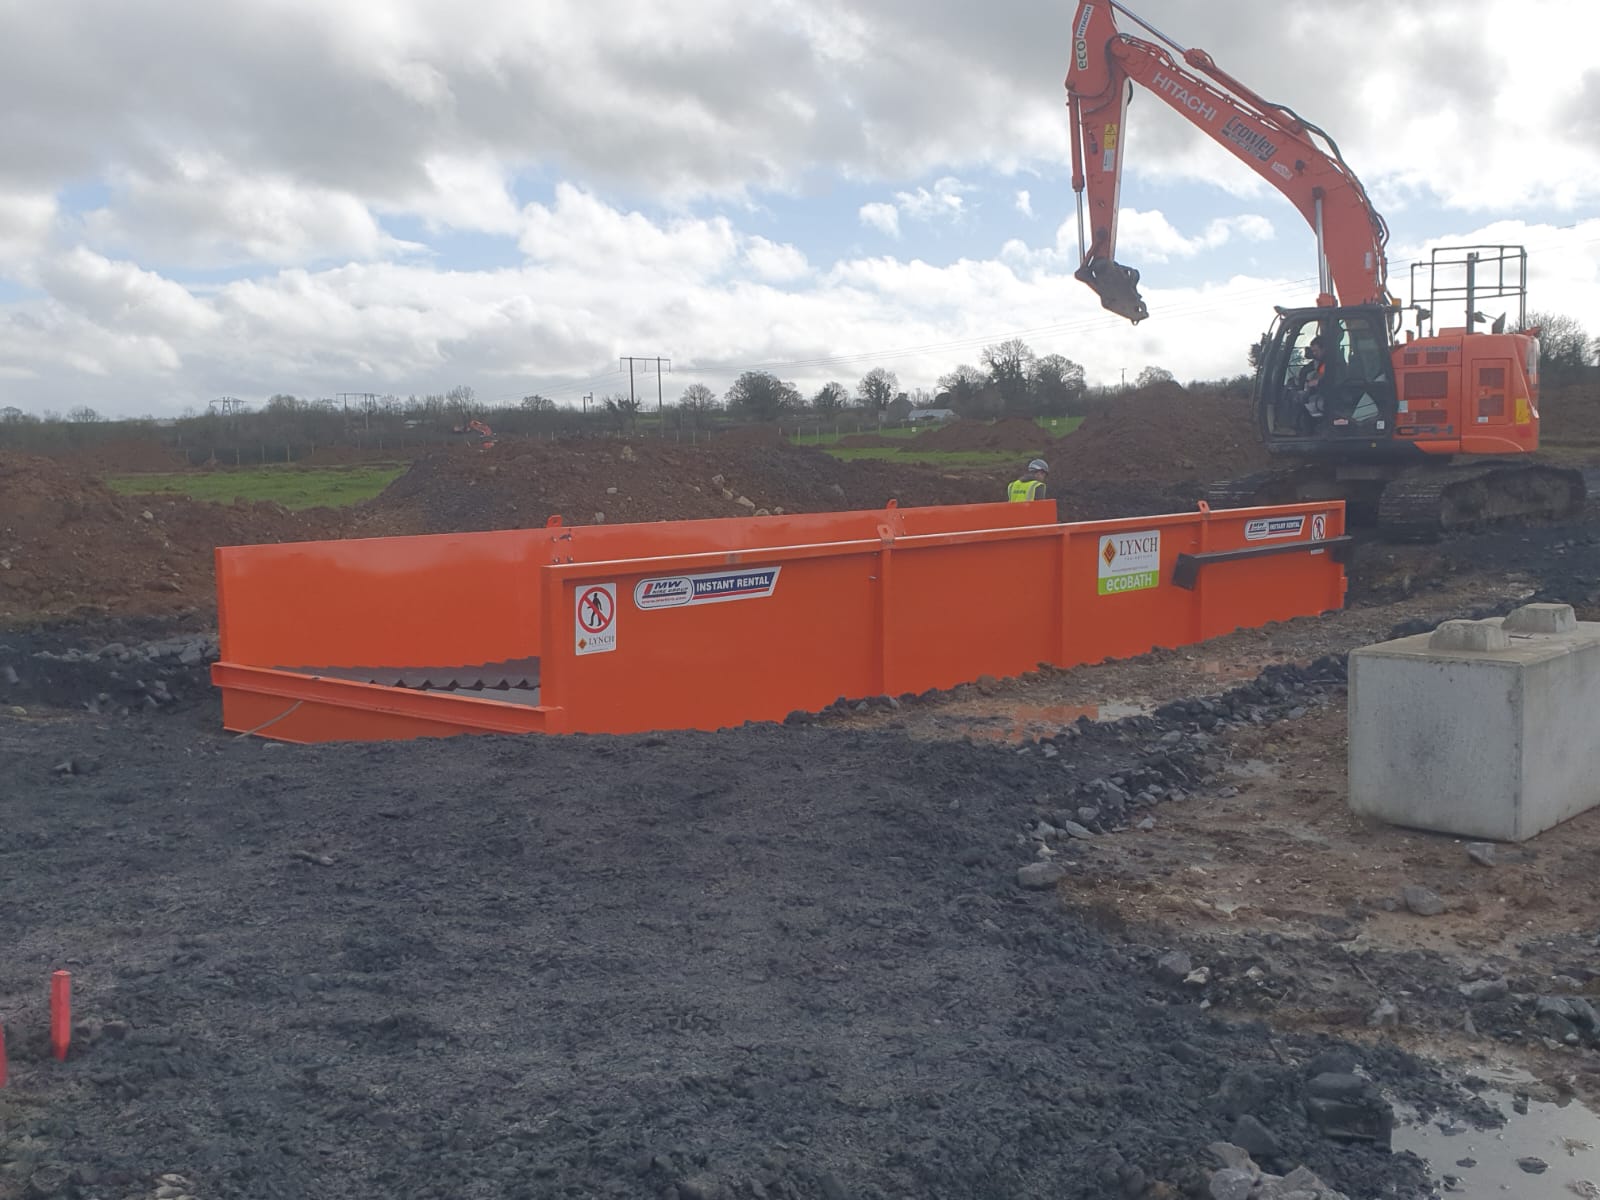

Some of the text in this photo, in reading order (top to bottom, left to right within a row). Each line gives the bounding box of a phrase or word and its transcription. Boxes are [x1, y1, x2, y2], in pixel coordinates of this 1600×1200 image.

[1078, 6, 1092, 37] HITACHI
[1152, 72, 1217, 121] HITACHI
[1226, 116, 1280, 160] Crowley
[1119, 536, 1159, 556] LYNCH
[654, 580, 682, 590] MW
[695, 575, 770, 592] INSTANT RENTAL
[588, 634, 615, 646] LYNCH
